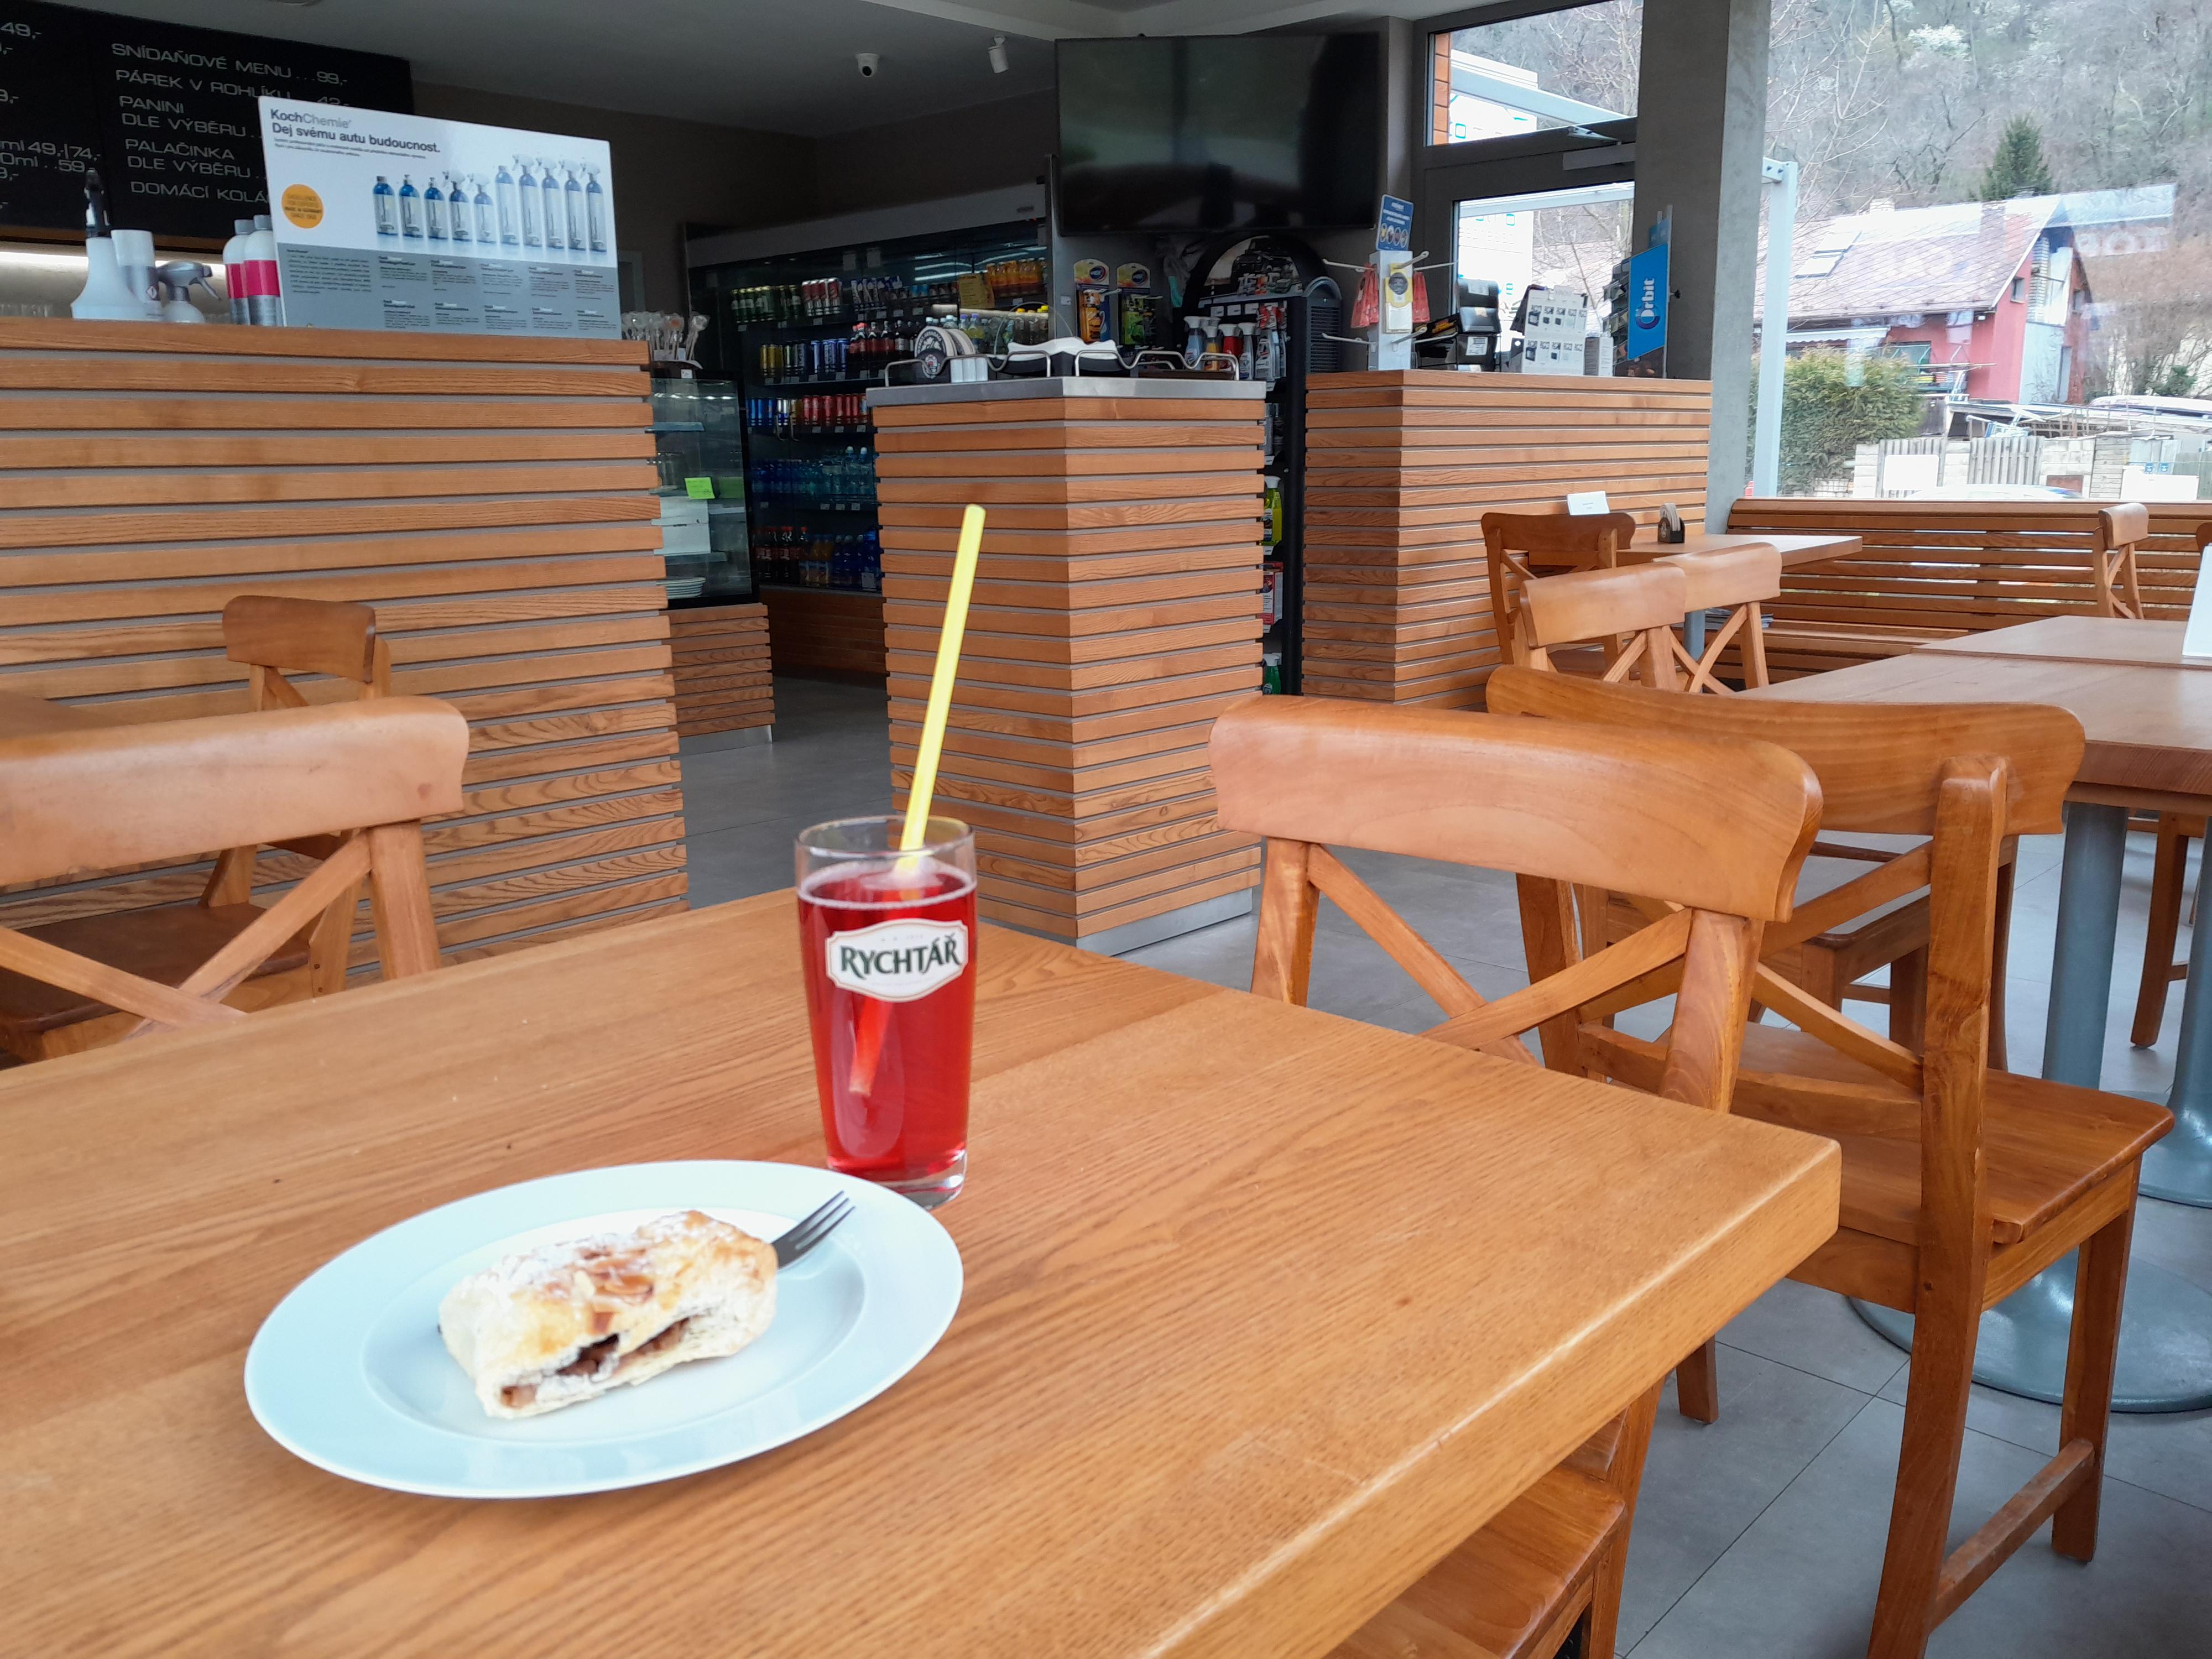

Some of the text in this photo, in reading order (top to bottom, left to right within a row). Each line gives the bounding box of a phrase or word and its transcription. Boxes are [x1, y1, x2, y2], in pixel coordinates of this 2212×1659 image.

[112, 43, 227, 70] SNÍDAŇOVÉ
[236, 60, 292, 78] MENU
[116, 69, 183, 89] PÁREK
[189, 79, 203, 91] V
[119, 95, 184, 113] PANINI
[122, 112, 247, 137] DLE VÝBĚRU
[125, 138, 235, 160] PALAČINKA
[272, 122, 293, 137] Dej
[296, 127, 336, 140] svému
[339, 133, 366, 144] autu
[369, 134, 441, 153] budoucnost.
[127, 155, 251, 178] DLE VÝBĚRU
[131, 181, 270, 204] DOMÁCÍ KOLÁ
[1635, 277, 1661, 330] Orbit
[840, 933, 963, 979] RYCHTÁŘ
